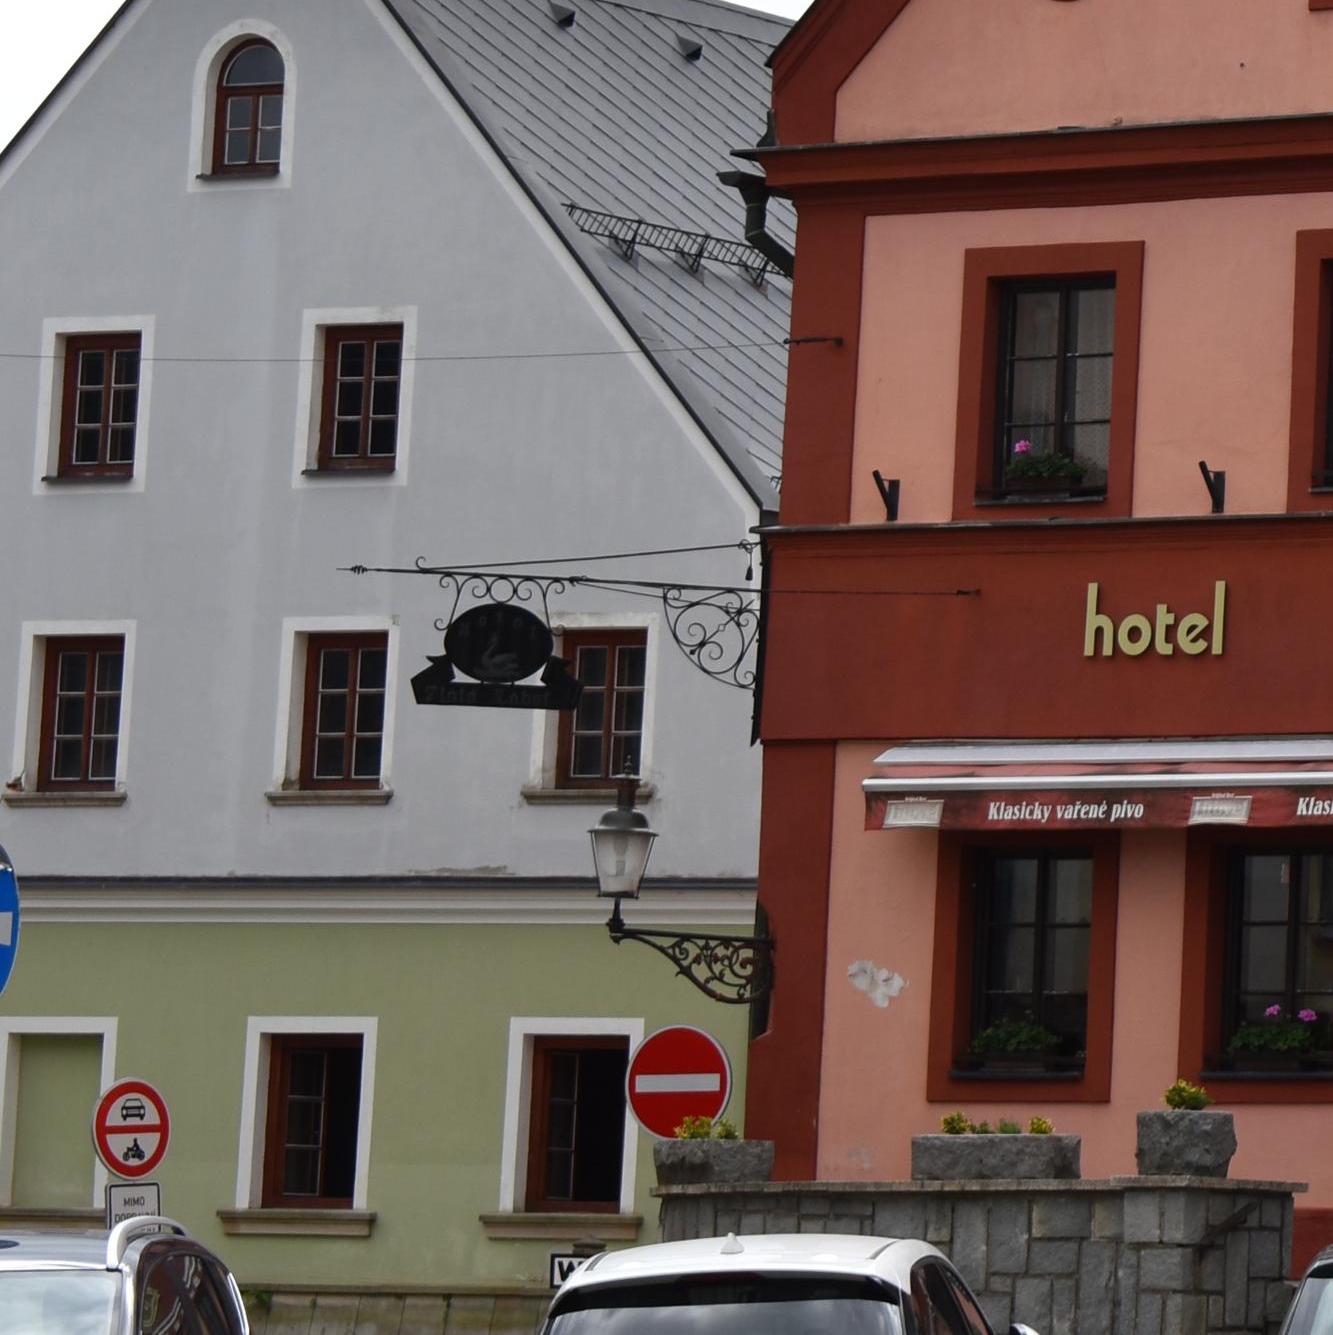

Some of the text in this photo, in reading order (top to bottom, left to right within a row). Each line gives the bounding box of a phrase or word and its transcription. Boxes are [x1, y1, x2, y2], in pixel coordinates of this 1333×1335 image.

[1083, 580, 1227, 658] hotel
[987, 800, 1144, 822] Klasicky vařené pivo
[123, 1196, 145, 1207] MIMO
